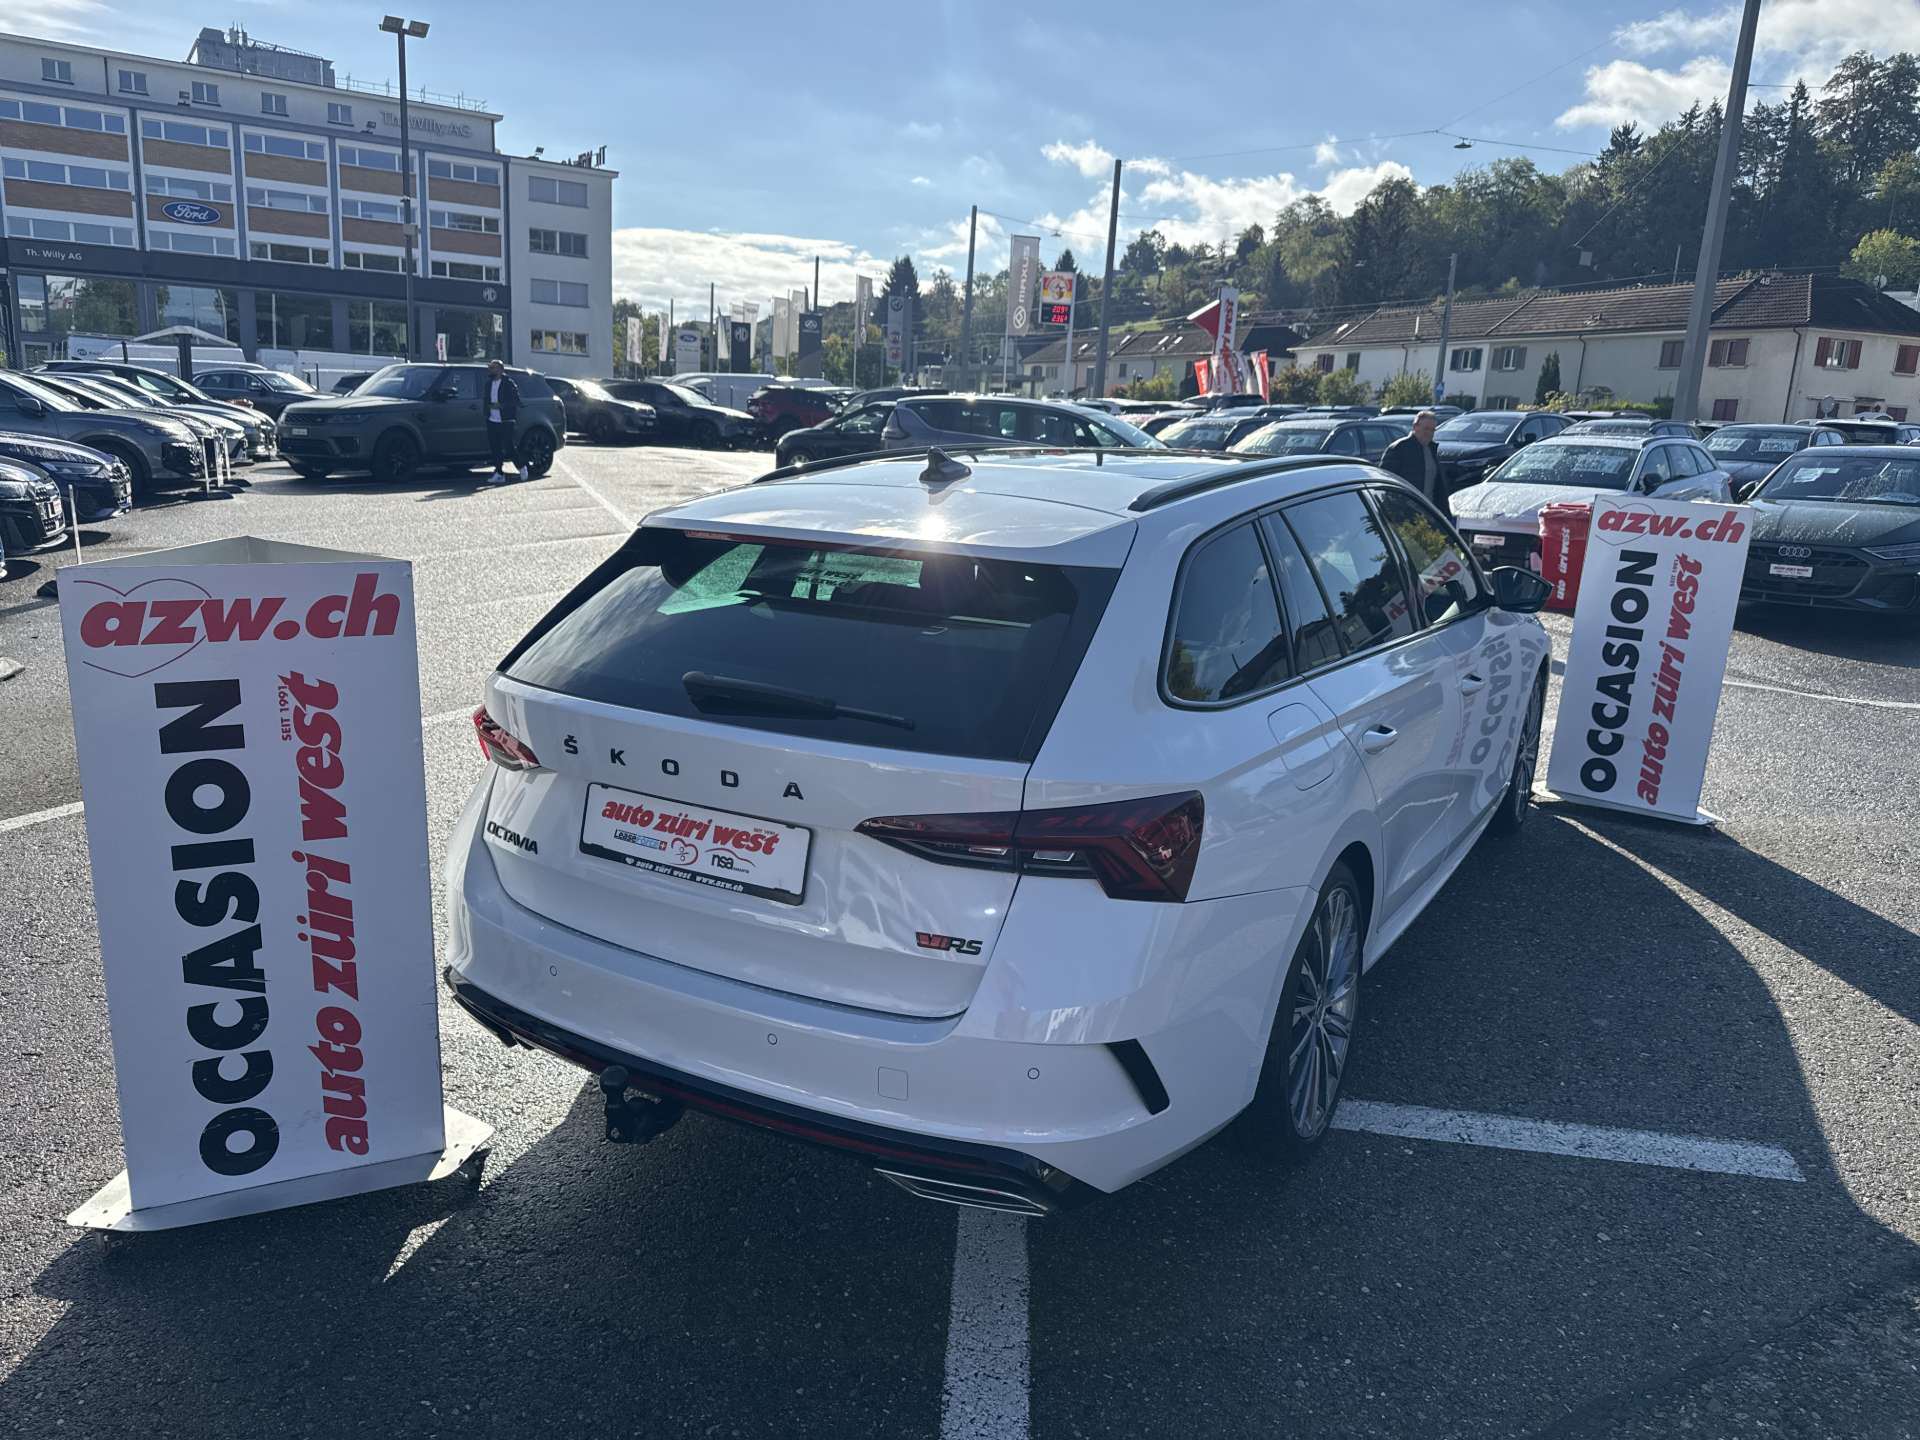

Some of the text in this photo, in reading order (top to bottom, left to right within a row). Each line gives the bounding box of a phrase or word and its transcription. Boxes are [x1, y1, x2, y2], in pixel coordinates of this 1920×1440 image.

[407, 116, 442, 136] Willy
[447, 123, 473, 138] AG
[25, 248, 82, 261] Th. Willy AG
[1017, 245, 1031, 303] MAXUS
[1597, 510, 1747, 543] azw.ch
[80, 573, 401, 649] azw.ch
[1580, 549, 1658, 793] OCCASION
[1636, 552, 1703, 806] auto züri west
[277, 685, 293, 741] SEIT 1991
[563, 735, 804, 800] ŠKODA
[487, 821, 538, 855] OCTAVIA
[601, 800, 654, 828] auto
[653, 813, 712, 842] züri
[712, 825, 780, 855] west
[636, 858, 654, 871] auto
[672, 868, 692, 880] west
[711, 854, 734, 870] nsa
[153, 678, 280, 1176] OCCASION
[277, 670, 369, 1156] auto züri west
